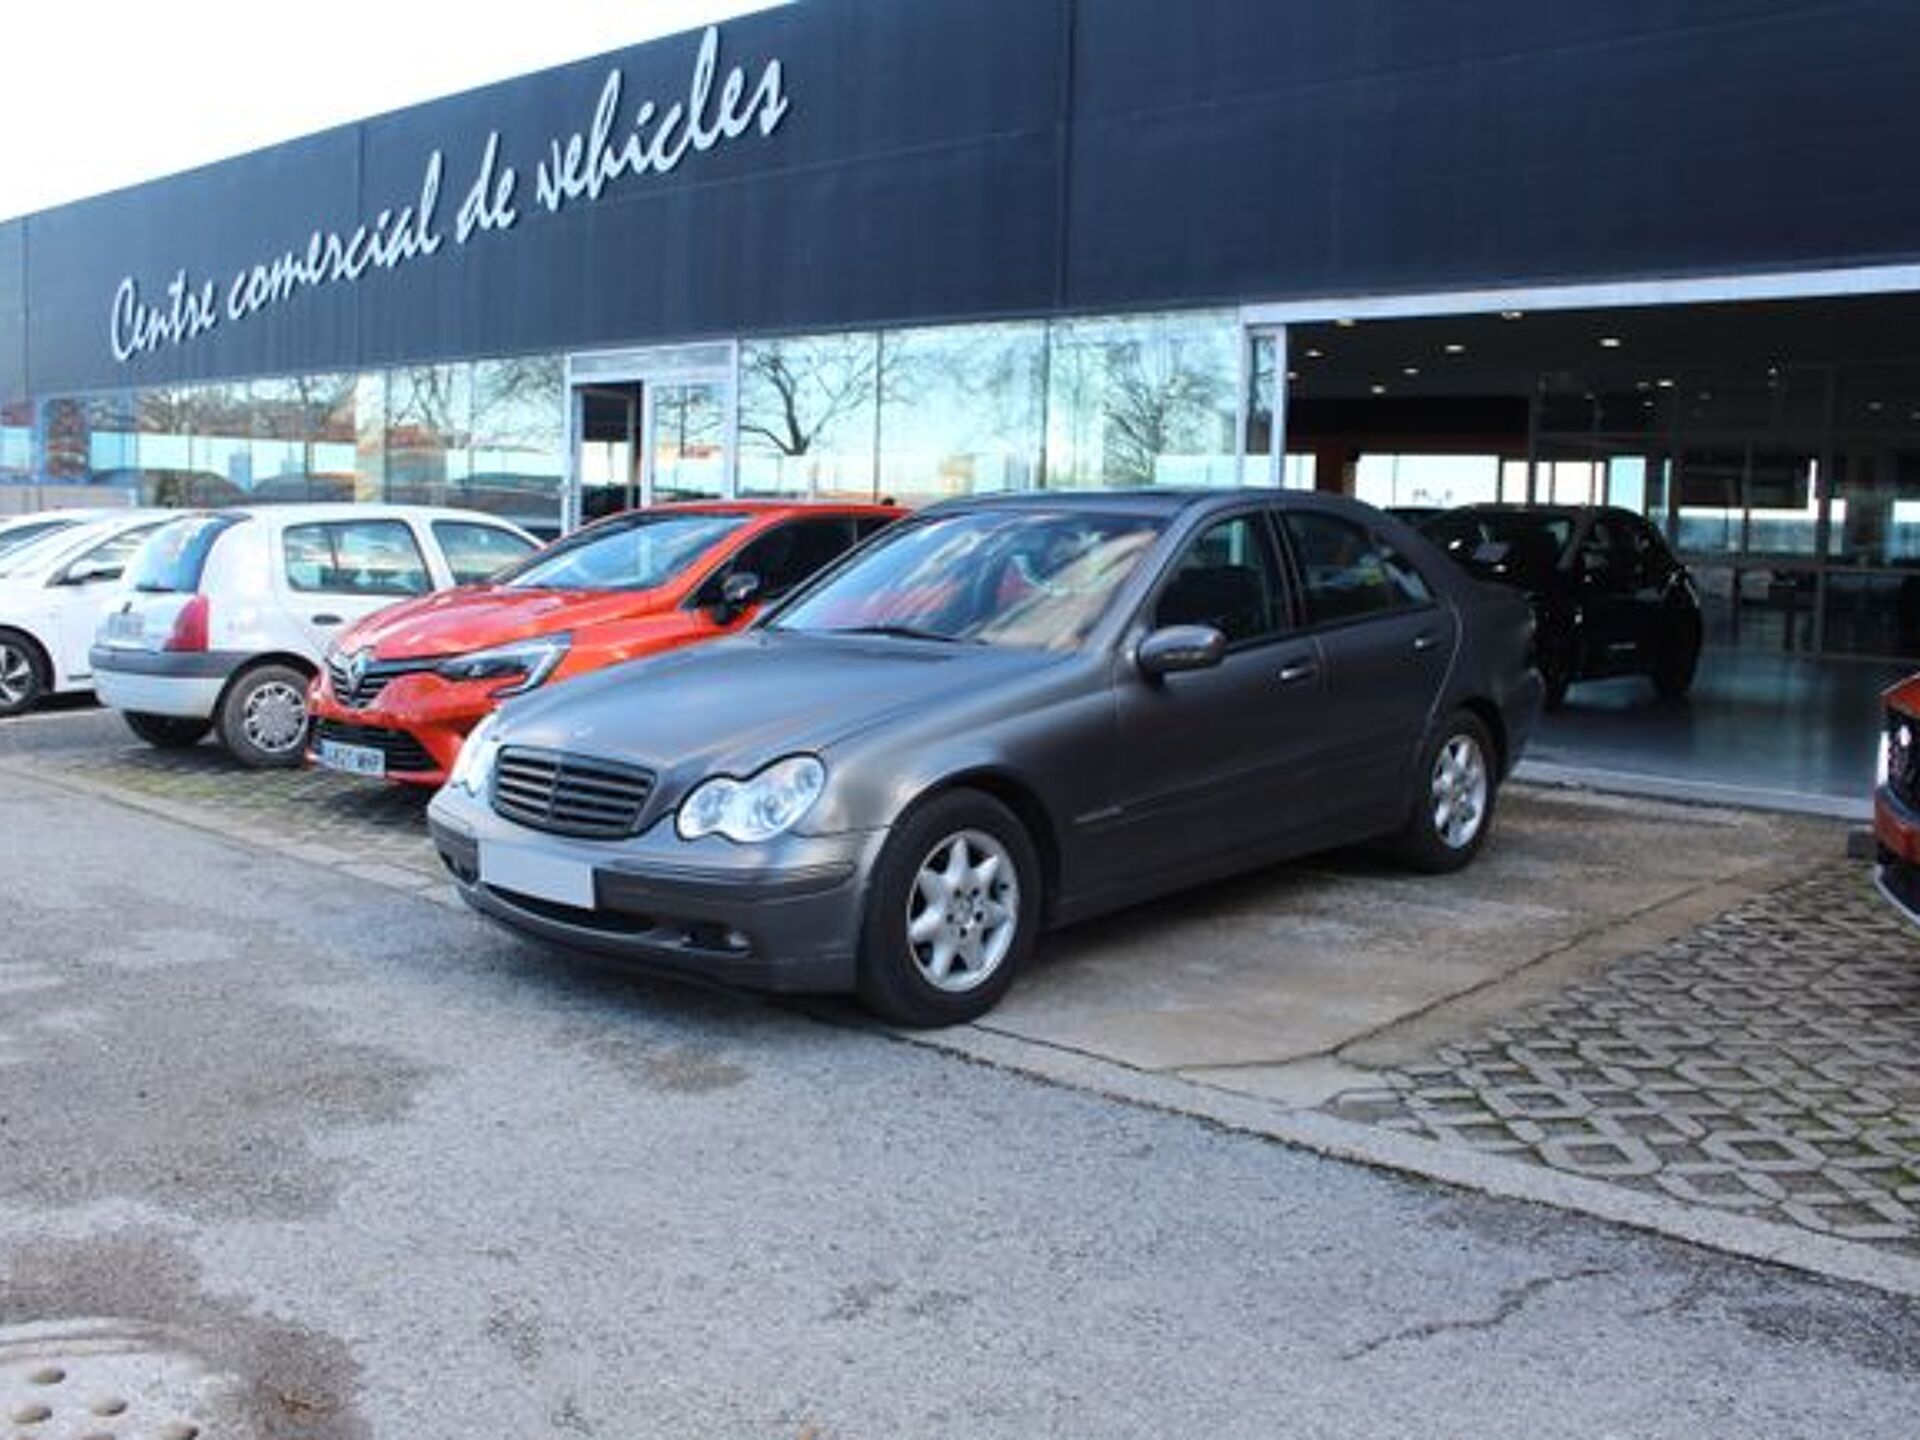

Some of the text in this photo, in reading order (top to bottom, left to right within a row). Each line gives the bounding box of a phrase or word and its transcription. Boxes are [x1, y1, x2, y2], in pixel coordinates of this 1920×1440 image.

[111, 26, 789, 362] Centre comercial de vehicles
